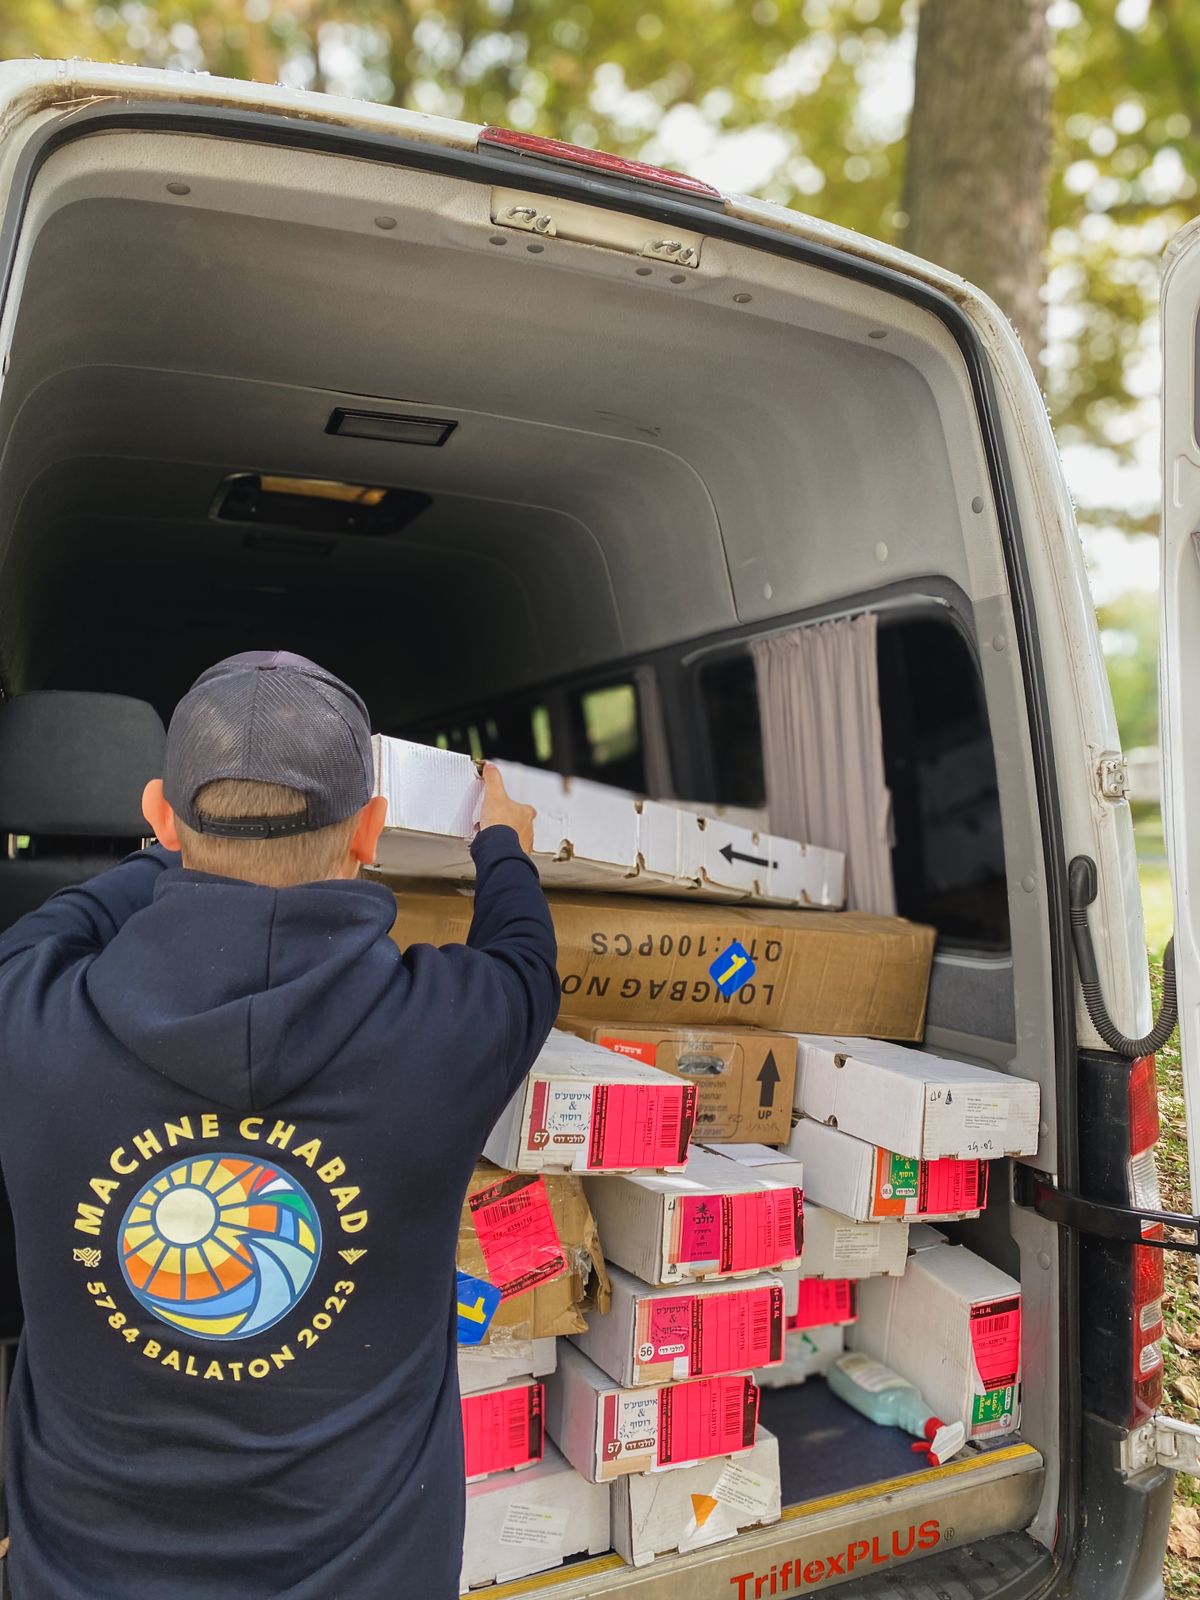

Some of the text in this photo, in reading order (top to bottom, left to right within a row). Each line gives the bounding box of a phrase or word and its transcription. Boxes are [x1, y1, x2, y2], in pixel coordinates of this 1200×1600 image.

[591, 932, 782, 962] QT:100PCS
[568, 1101, 577, 1111] &
[758, 1110, 772, 1120] UP
[533, 1132, 548, 1144] 57
[74, 1114, 369, 1236] MACHNE CHABAD
[87, 1281, 355, 1381] 5784 BALATON 2023
[640, 1346, 653, 1357] 56
[607, 1441, 620, 1453] 57
